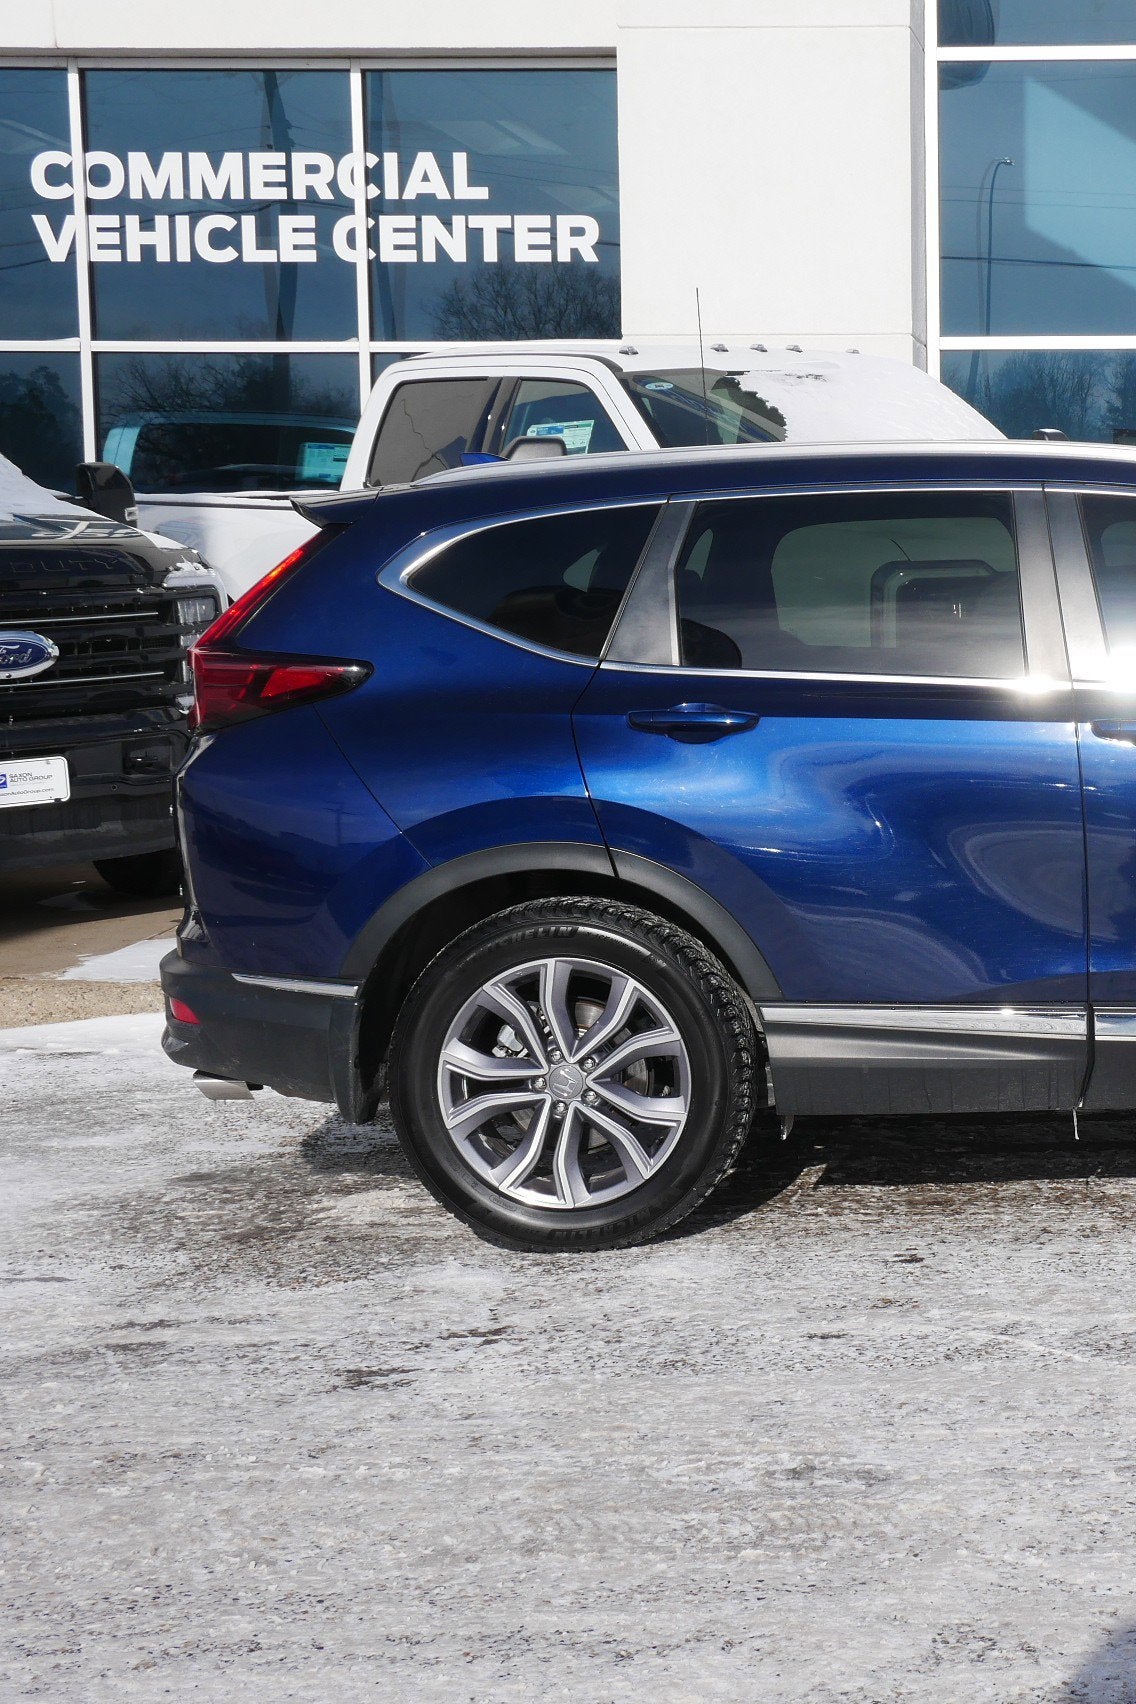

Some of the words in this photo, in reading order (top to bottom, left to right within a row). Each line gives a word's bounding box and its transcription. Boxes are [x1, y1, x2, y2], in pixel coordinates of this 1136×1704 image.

[30, 150, 489, 201] COMMERCIAL
[31, 214, 318, 263] VEHICLE
[332, 214, 600, 263] CENTER
[28, 774, 53, 782] GROUP
